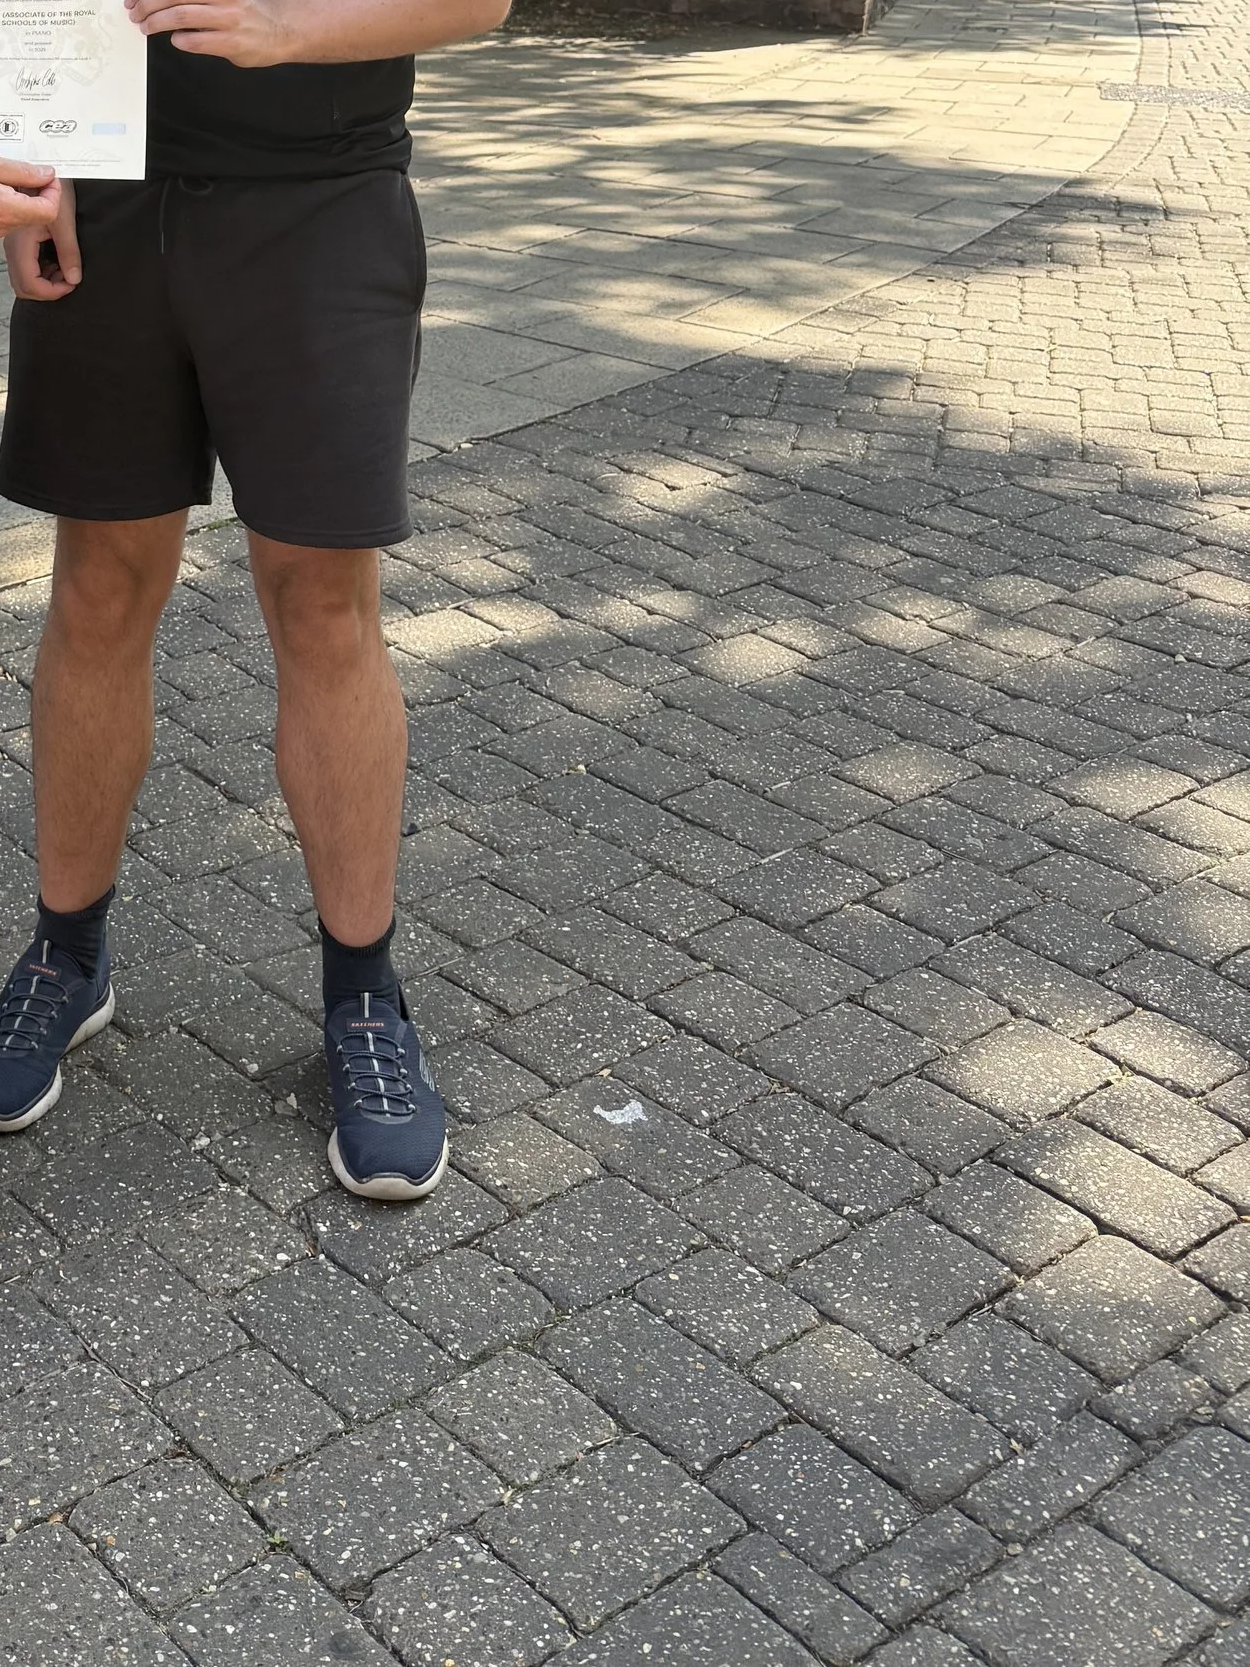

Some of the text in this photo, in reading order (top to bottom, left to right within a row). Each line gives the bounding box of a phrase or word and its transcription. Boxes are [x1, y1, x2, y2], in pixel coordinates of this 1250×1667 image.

[2, 11, 45, 19] (ASSOCIATE
[73, 9, 96, 17] ROYAL
[39, 119, 78, 133] cea
